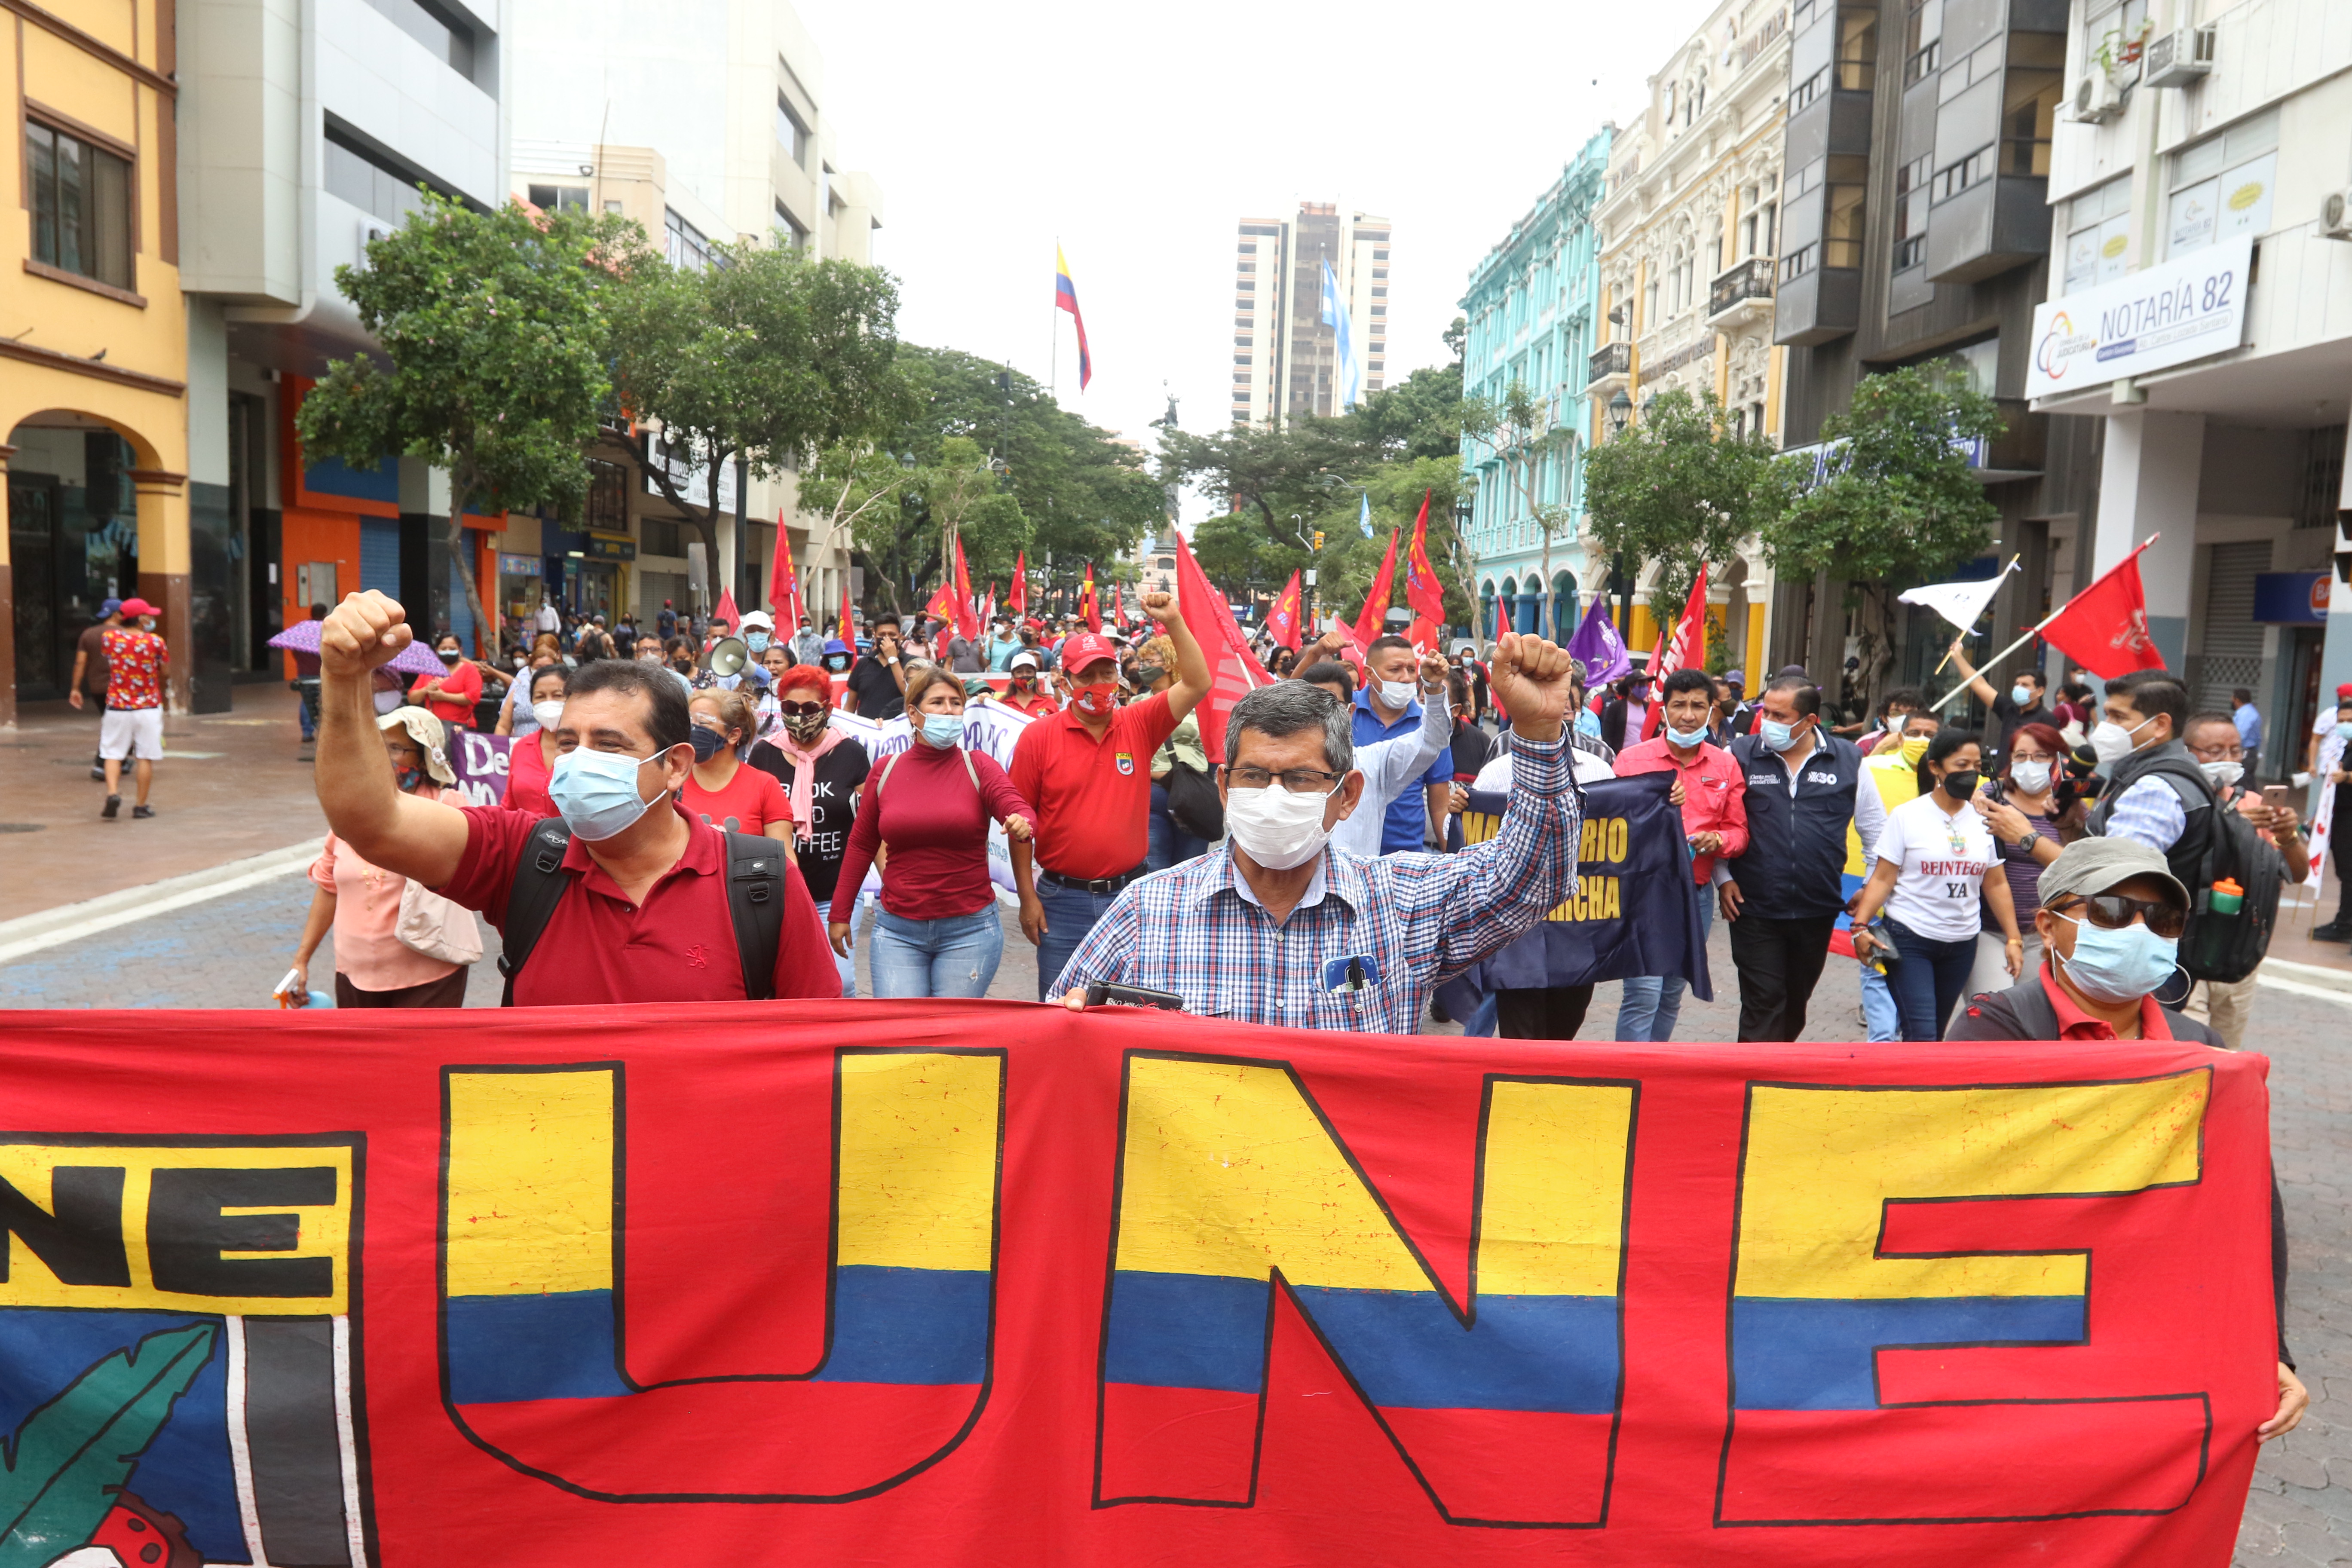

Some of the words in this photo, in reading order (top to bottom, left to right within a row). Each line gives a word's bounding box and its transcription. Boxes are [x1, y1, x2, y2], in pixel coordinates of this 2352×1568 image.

[2101, 278, 2193, 343] NOTARÍA
[2202, 270, 2233, 312] 82
[1946, 882, 1969, 898] YA
[438, 1047, 2214, 1528] UNE
